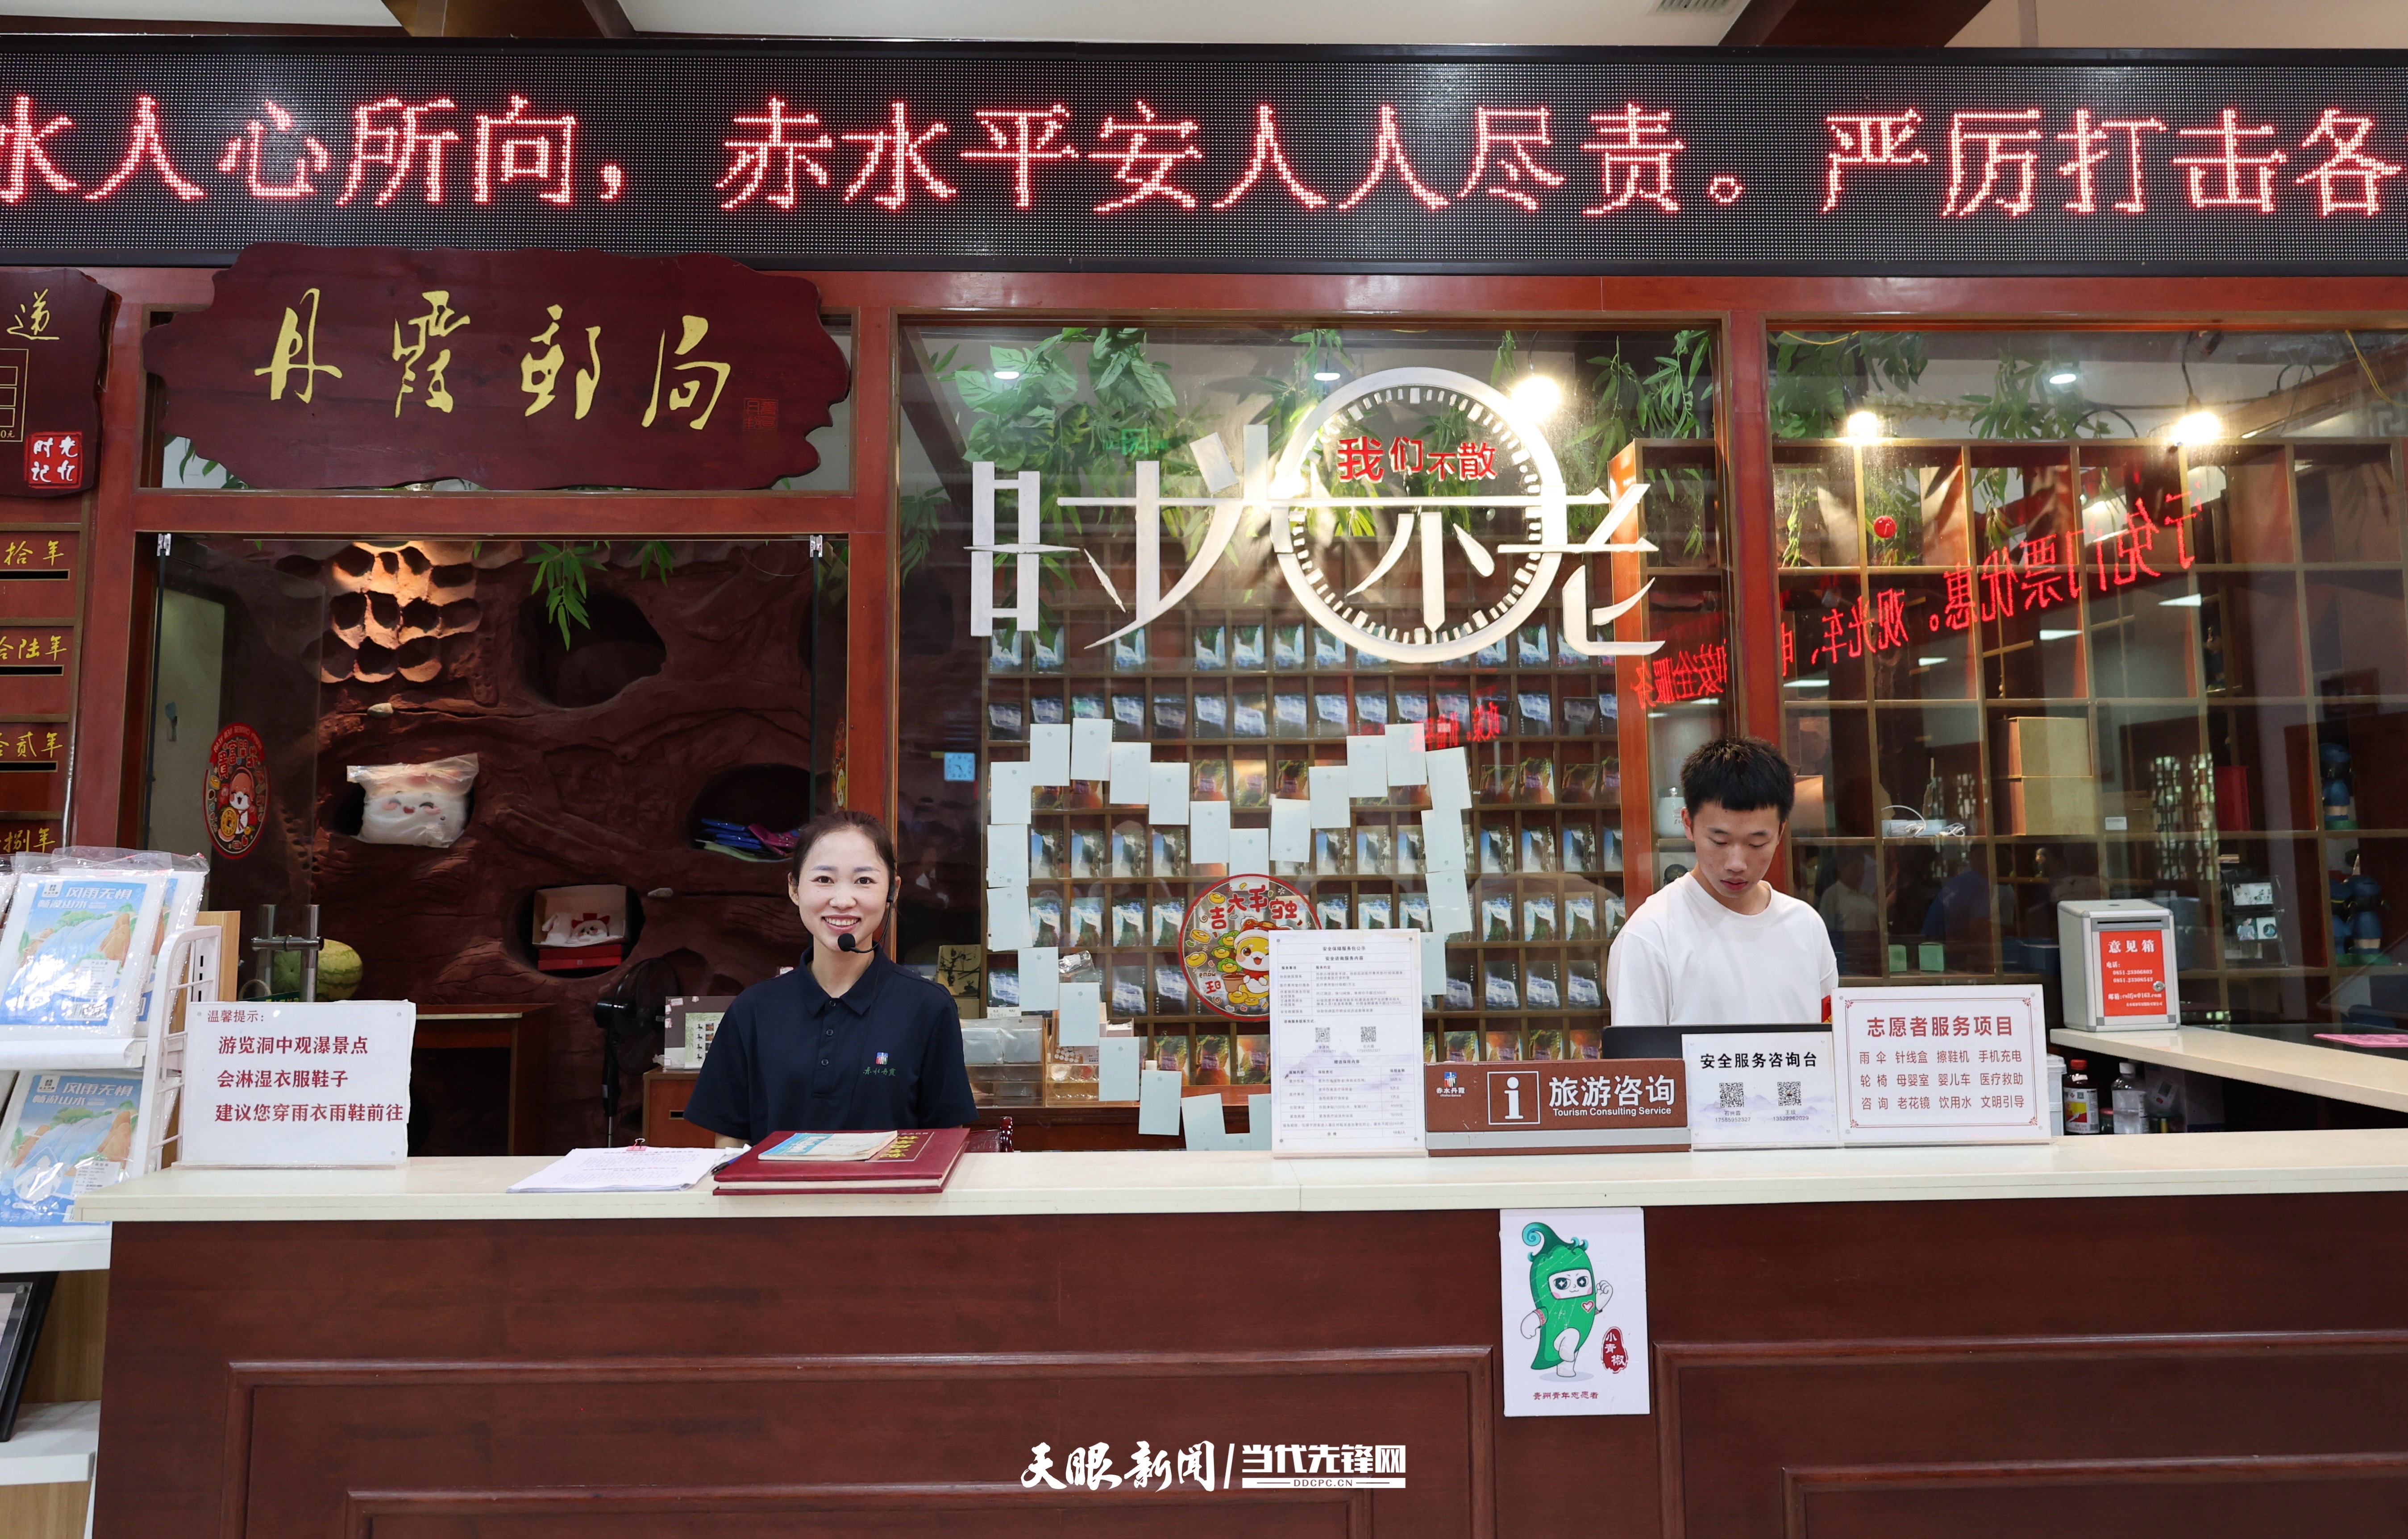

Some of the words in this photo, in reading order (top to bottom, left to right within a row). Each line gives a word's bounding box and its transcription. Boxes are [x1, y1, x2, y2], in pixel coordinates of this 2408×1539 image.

[33, 436, 79, 458] 时光
[1337, 436, 1497, 483] 我们不散
[31, 460, 74, 482] 记忆
[66, 887, 133, 900] 风雨无惧
[2108, 939, 2155, 953] 意见箱
[1867, 1016, 2013, 1037] 志愿者服务项目
[218, 1036, 368, 1055] 游览洞中观瀑景点
[1700, 1052, 1817, 1069] 安全服务咨询台
[1895, 1050, 1928, 1064] 针线盒
[1937, 1050, 1970, 1063] 擦鞋机
[1979, 1049, 2022, 1063] 手机充电
[217, 1070, 349, 1088] 会淋湿衣服鞋子
[1896, 1073, 1929, 1087] 母婴室
[1938, 1073, 1971, 1086] 婴儿车
[1980, 1072, 2023, 1086] 医疗救助
[62, 1083, 133, 1097] 风雨无惧
[1549, 1074, 1675, 1108] 旅游咨询
[1897, 1096, 1930, 1110] 老花镜
[1939, 1096, 1972, 1109] 饮用水
[1981, 1095, 2024, 1108] 文明引导
[214, 1103, 403, 1122] 建议您穿雨衣雨鞋前往
[1553, 1107, 1588, 1116] Tourism
[1589, 1107, 1637, 1117] Consulting
[1639, 1106, 1672, 1115] Service
[1604, 1332, 1626, 1367] 小青椒
[1533, 1390, 1599, 1400] 贵州青年志愿者
